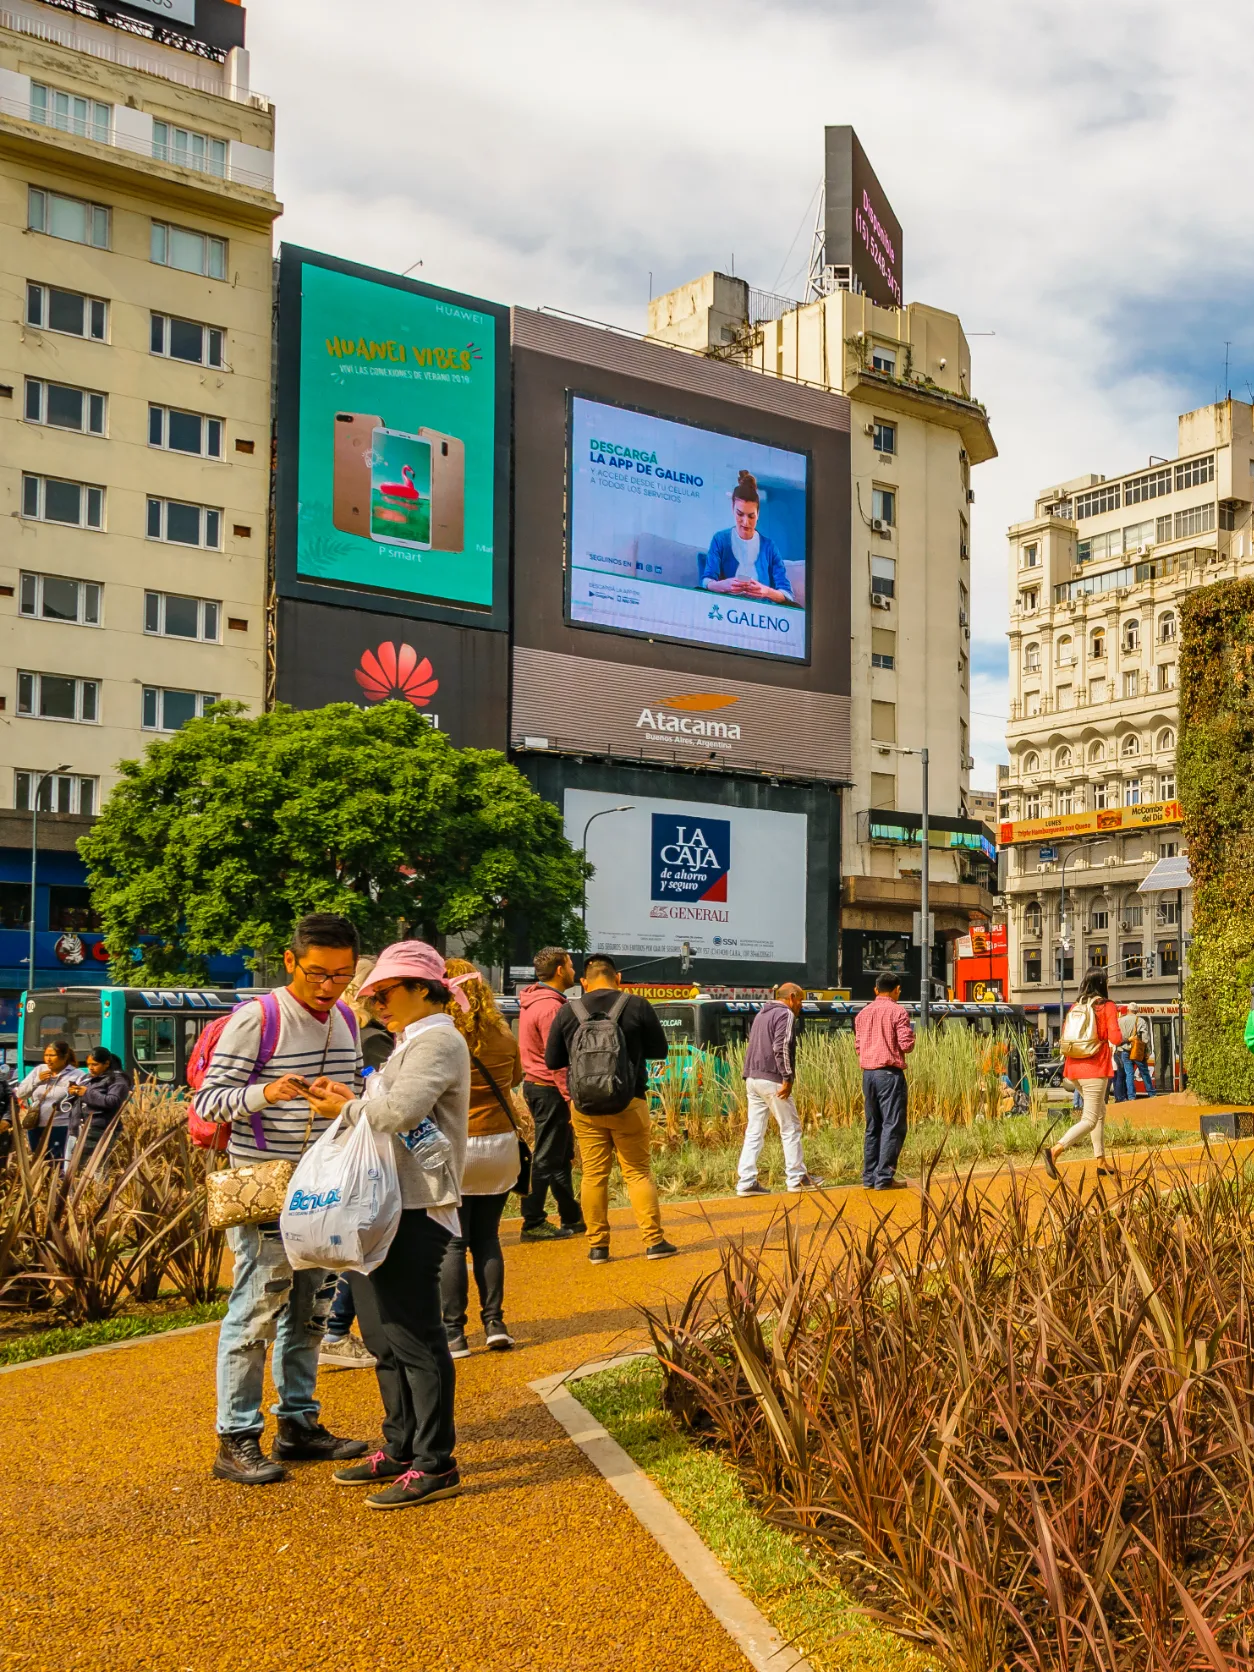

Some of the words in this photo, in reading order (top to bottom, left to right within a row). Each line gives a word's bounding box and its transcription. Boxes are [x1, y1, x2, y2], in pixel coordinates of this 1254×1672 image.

[856, 207, 869, 250] (15)
[863, 189, 895, 264] Disponible
[436, 304, 483, 324] HUAWEI
[326, 336, 406, 363] HUAWEI
[412, 346, 472, 371] VIBES
[355, 366, 368, 376] LAS
[370, 367, 412, 379] CONEXIONES
[414, 370, 422, 380] DE
[424, 372, 450, 382] VERANO
[452, 374, 470, 384] 2019
[590, 438, 658, 464] DESCARGÁ
[590, 451, 606, 464] LA
[609, 456, 633, 470] APP
[636, 462, 652, 476] DE
[655, 467, 704, 487] GALENO
[590, 476, 596, 484] A
[598, 478, 625, 490] TODOS
[627, 486, 641, 495] LOS
[643, 488, 682, 504] SERVICIOS
[630, 476, 655, 488] DESDE
[657, 480, 666, 491] TU
[668, 485, 700, 498] CELULAR
[379, 546, 386, 555] P
[388, 549, 422, 562] smart
[726, 609, 790, 633] GALENO
[636, 708, 740, 740] Atacama
[645, 732, 673, 742] Buenos
[674, 736, 695, 746] Aires,
[696, 739, 732, 749] Argentina
[1132, 806, 1163, 816] McCombo
[1142, 814, 1152, 822] del
[676, 826, 709, 848] LA
[660, 844, 722, 872] CAJA
[660, 868, 672, 879] de
[674, 868, 708, 882] ahorro
[660, 880, 668, 892] y
[668, 881, 698, 892] seguro
[669, 906, 730, 922] GENERALI
[722, 938, 738, 946] SSN
[618, 988, 690, 998] AXIKIOSCO
